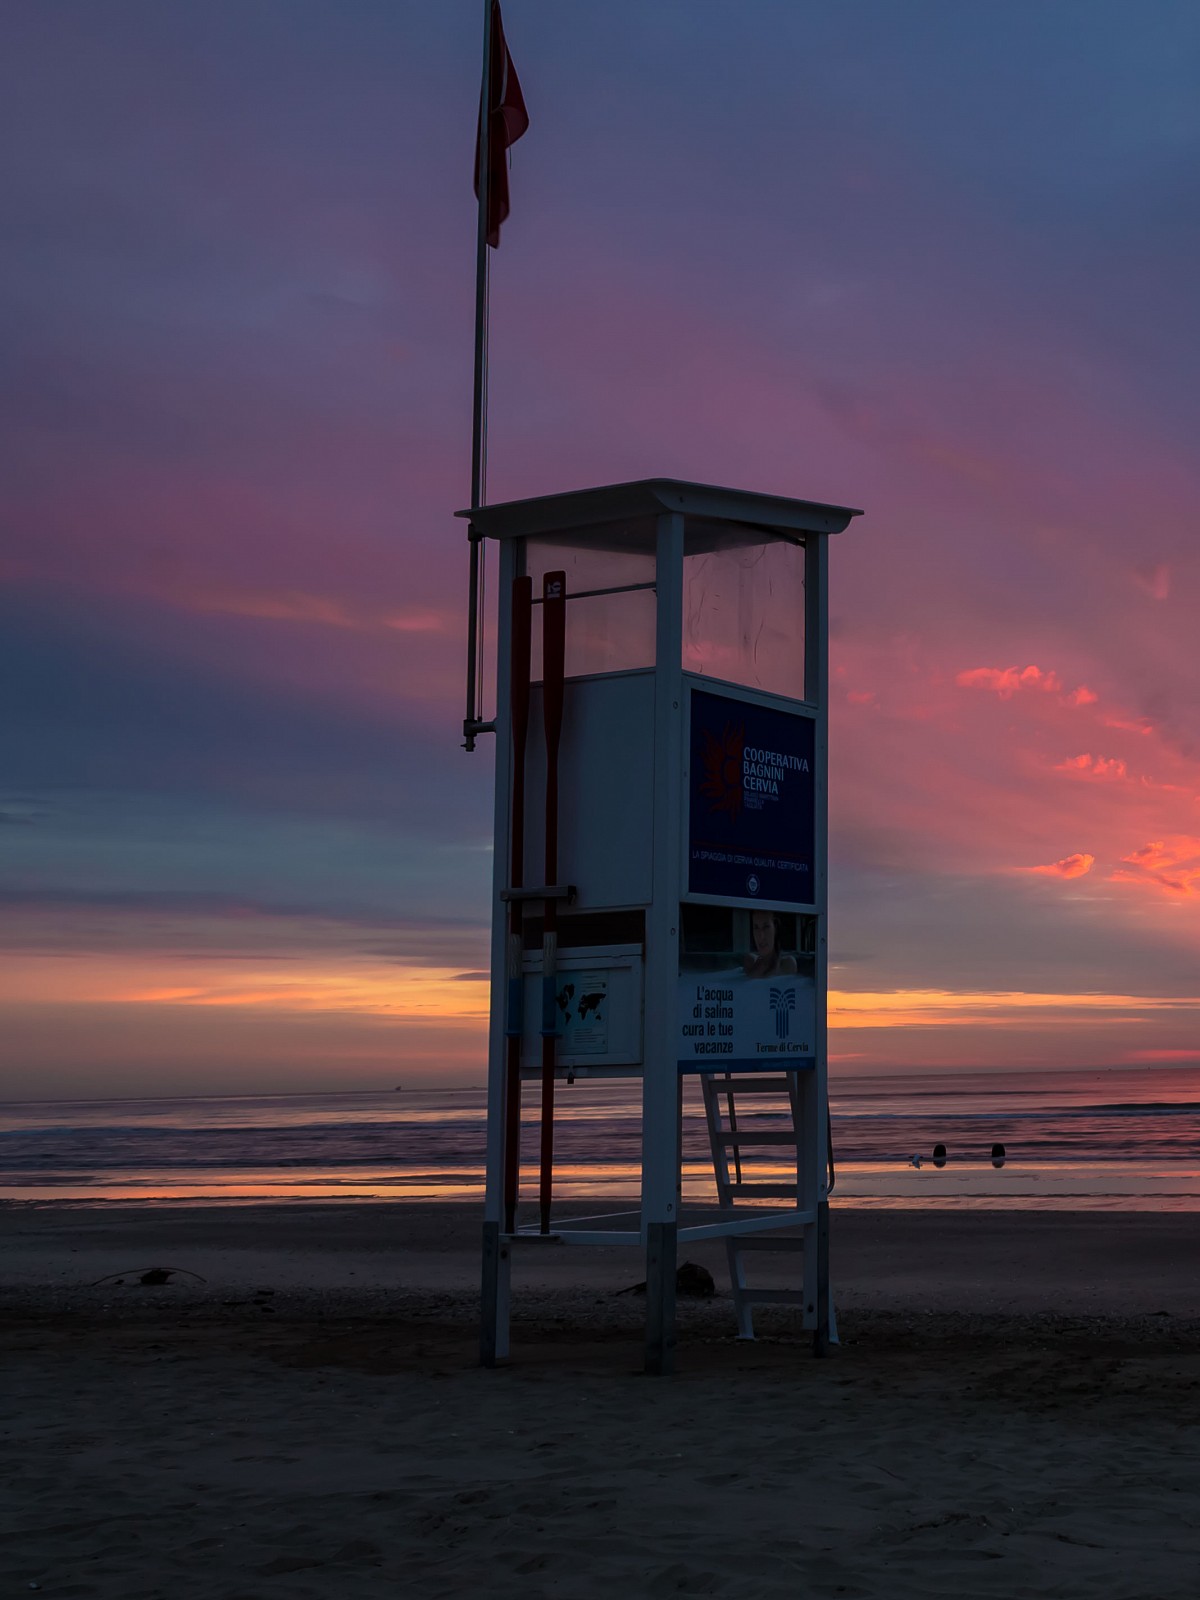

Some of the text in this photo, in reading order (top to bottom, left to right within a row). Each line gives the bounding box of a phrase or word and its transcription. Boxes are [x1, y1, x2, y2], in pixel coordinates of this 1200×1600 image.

[744, 746, 809, 773] COOPERATIVA
[744, 760, 784, 782] BAGNINI
[744, 776, 779, 795] CERVIA
[697, 986, 734, 1004] L'acqua
[693, 1004, 734, 1018] di salina
[682, 1022, 734, 1036] cura le tue
[694, 1042, 734, 1054] vacanze
[779, 1042, 786, 1052] di
[787, 1042, 808, 1052] Cervia
